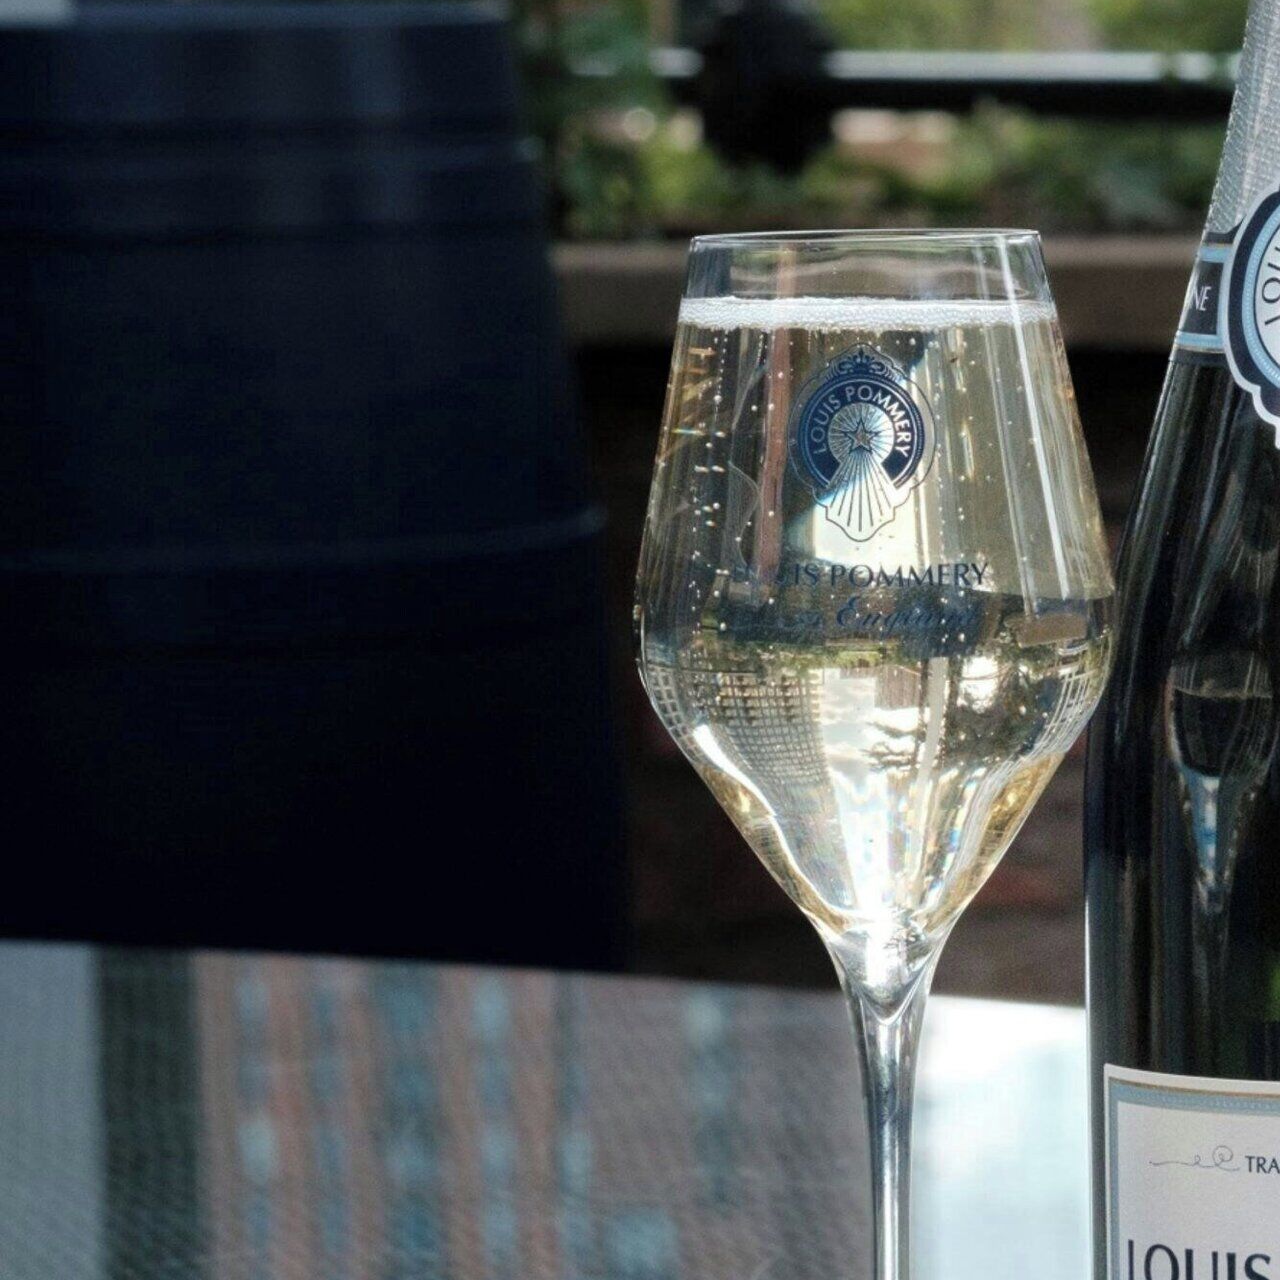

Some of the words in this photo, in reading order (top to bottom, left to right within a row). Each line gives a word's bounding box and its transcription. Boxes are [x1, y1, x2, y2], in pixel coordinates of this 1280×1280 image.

[811, 394, 841, 455] LOUIS
[845, 384, 912, 458] POMMERY
[830, 562, 989, 588] POMMERY
